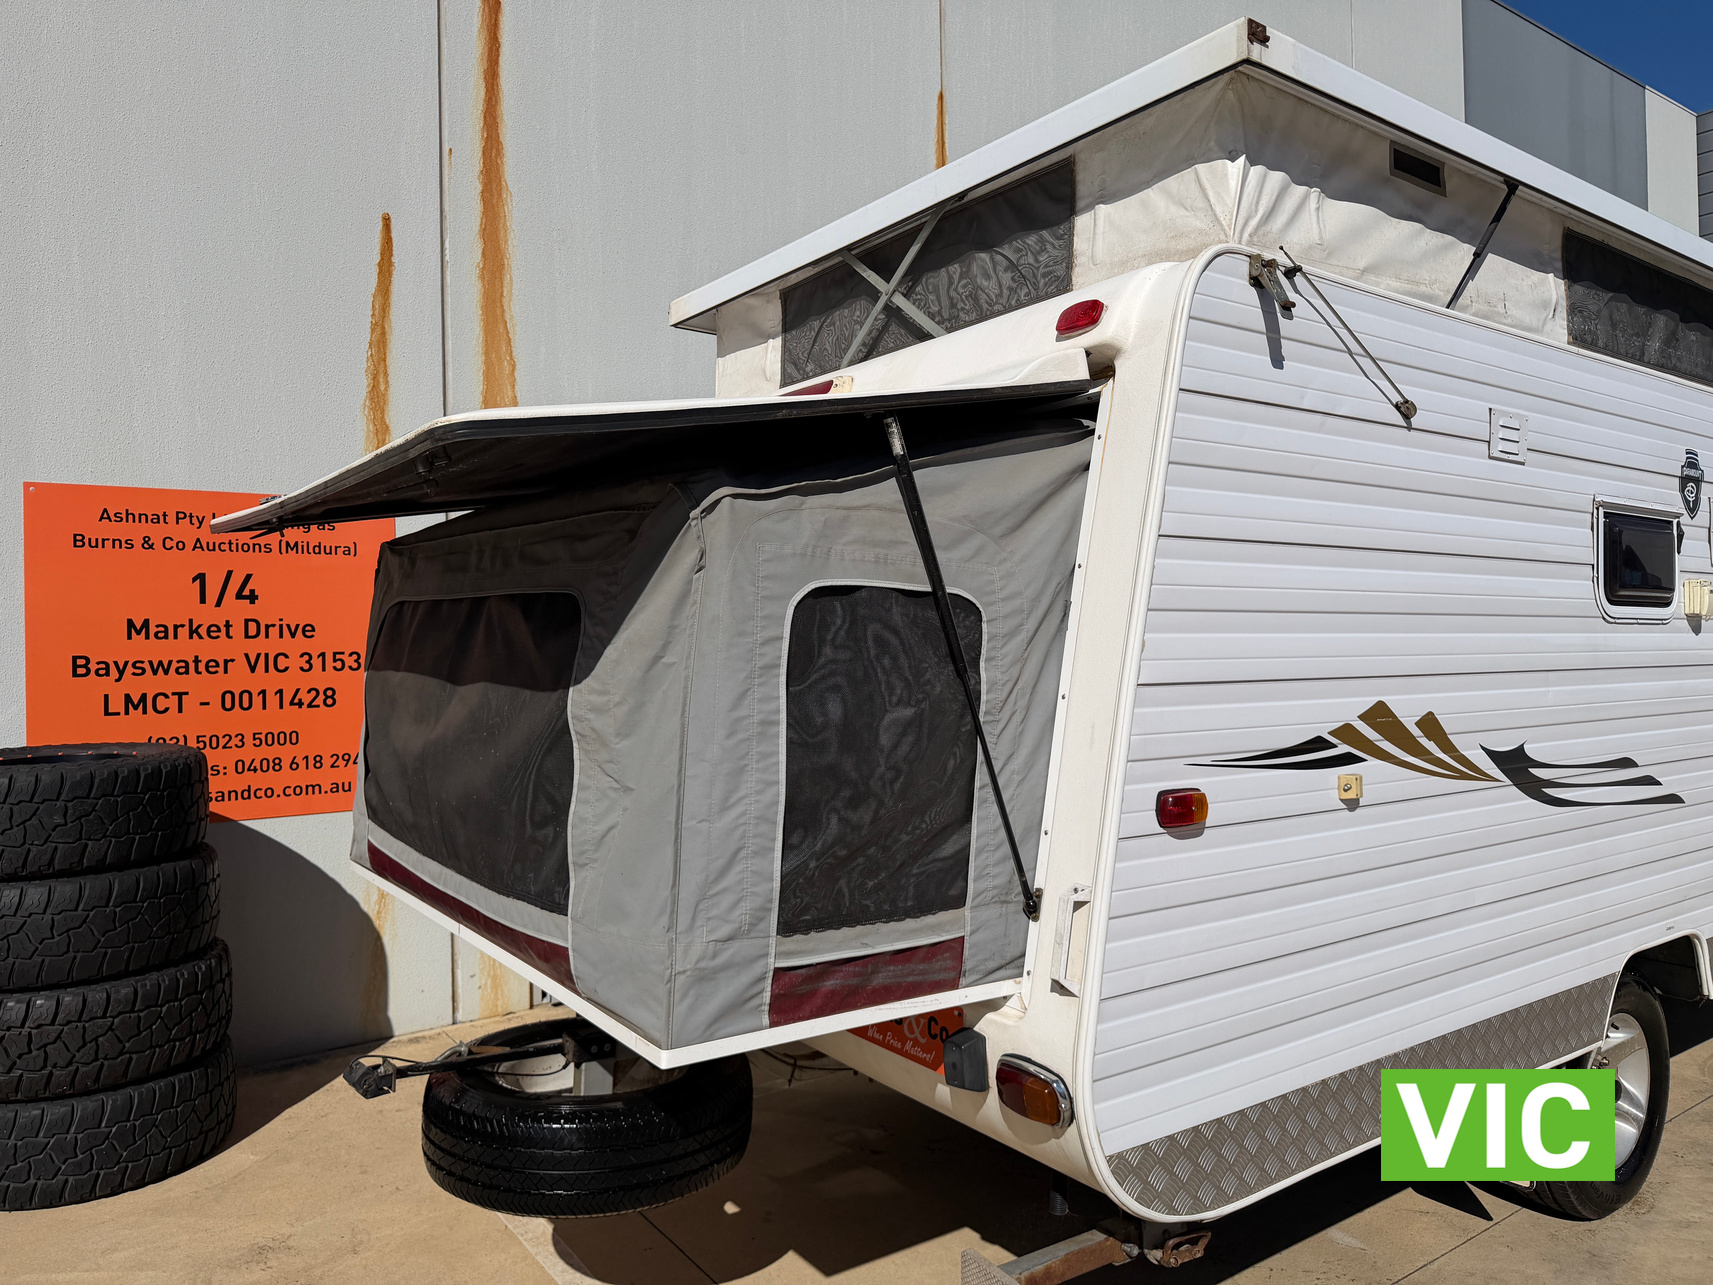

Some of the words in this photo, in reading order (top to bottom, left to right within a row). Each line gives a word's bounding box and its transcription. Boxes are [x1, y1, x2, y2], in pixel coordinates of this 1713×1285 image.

[99, 508, 169, 525] Ashnat
[175, 510, 206, 530] Pty
[72, 534, 135, 550] Burns
[141, 536, 156, 551] &
[162, 537, 186, 552] Co
[192, 537, 273, 554] Auctions
[278, 540, 358, 558] (Mildura)
[191, 570, 259, 608] 1/4
[126, 618, 234, 641] Market
[243, 618, 316, 640] Drive
[71, 654, 236, 683] Bayswater
[244, 653, 290, 674] VIC
[298, 651, 362, 673] 3153
[103, 692, 190, 717] LMCT
[220, 687, 337, 712] 0011428
[196, 733, 246, 751] 5023
[253, 731, 300, 748] 5000
[234, 757, 283, 775] 0408
[289, 755, 324, 772] 618
[867, 1025, 884, 1042] When
[885, 1031, 903, 1049] Price
[903, 1040, 936, 1063] Matters!
